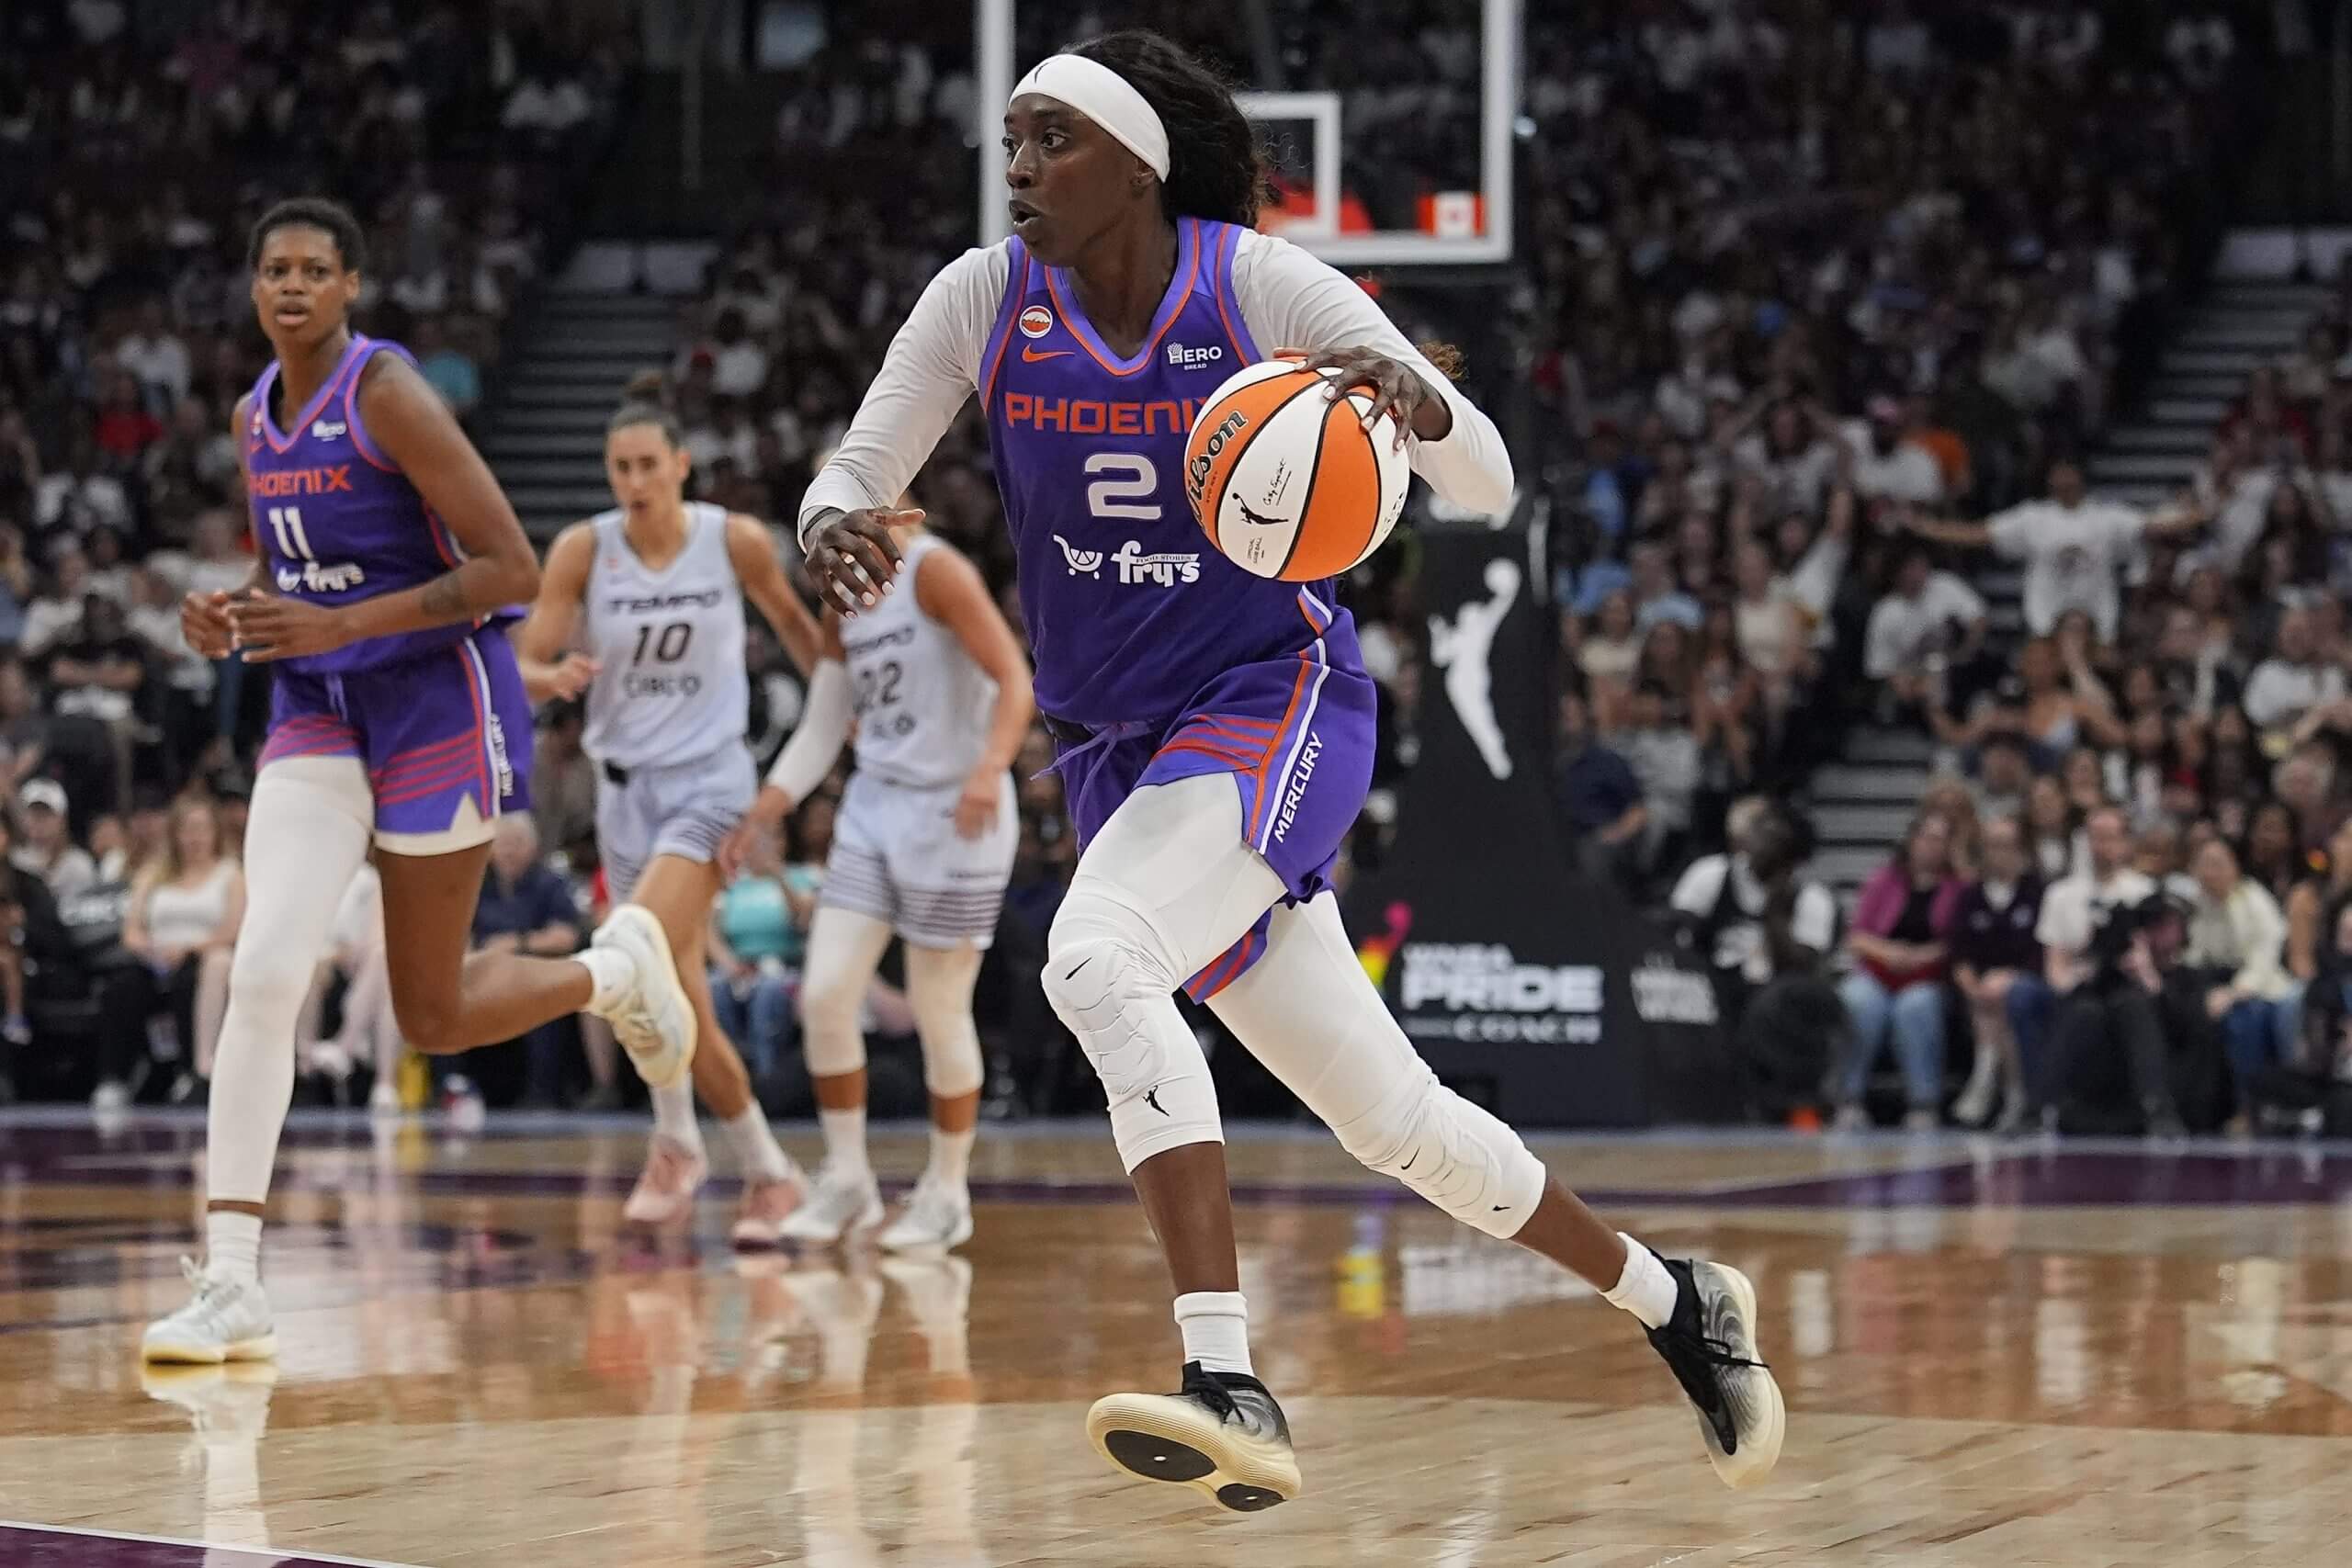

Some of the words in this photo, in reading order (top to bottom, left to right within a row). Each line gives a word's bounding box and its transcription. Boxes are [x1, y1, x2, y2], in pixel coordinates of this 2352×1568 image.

[1167, 342, 1222, 365] HERO
[1084, 453, 1162, 521] 2
[268, 507, 314, 560] 11
[1110, 540, 1201, 589] fry's
[633, 622, 692, 667] 10
[1274, 731, 1323, 843] MERCURY
[1401, 964, 1604, 1012] PRIDE
